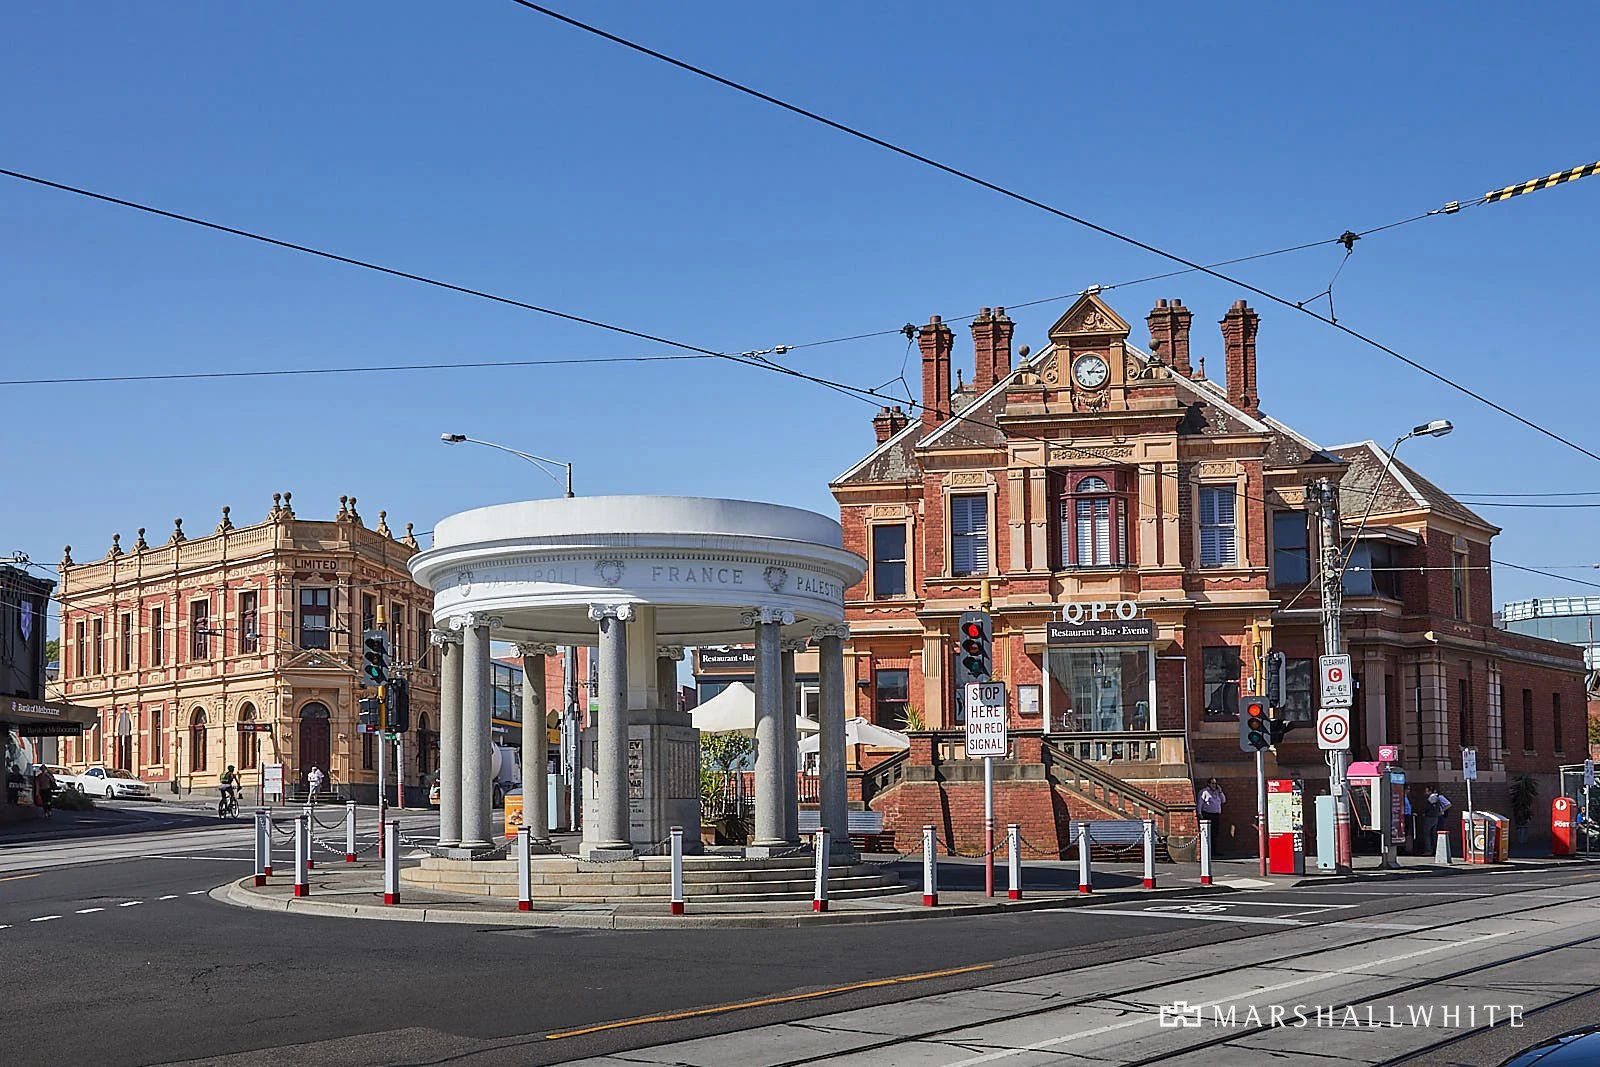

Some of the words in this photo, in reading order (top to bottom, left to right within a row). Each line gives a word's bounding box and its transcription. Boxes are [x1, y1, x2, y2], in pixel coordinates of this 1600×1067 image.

[294, 559, 337, 570] LIMITED
[651, 566, 743, 585] FRANCE
[1051, 628, 1095, 638] Restaurant
[1100, 626, 1117, 636] Bar
[1121, 626, 1149, 635] Events
[702, 654, 738, 663] Restaurant
[742, 653, 756, 662] Bar
[1330, 669, 1341, 681] C
[971, 686, 1000, 701] STOP
[18, 703, 30, 713] Bank
[35, 705, 60, 715] Melbourne
[971, 704, 1001, 719] HERE
[969, 723, 982, 734] ON
[984, 722, 1003, 733] RED
[1324, 722, 1343, 735] 60
[969, 738, 1003, 750] SIGNAL
[1554, 820, 1570, 828] POST
